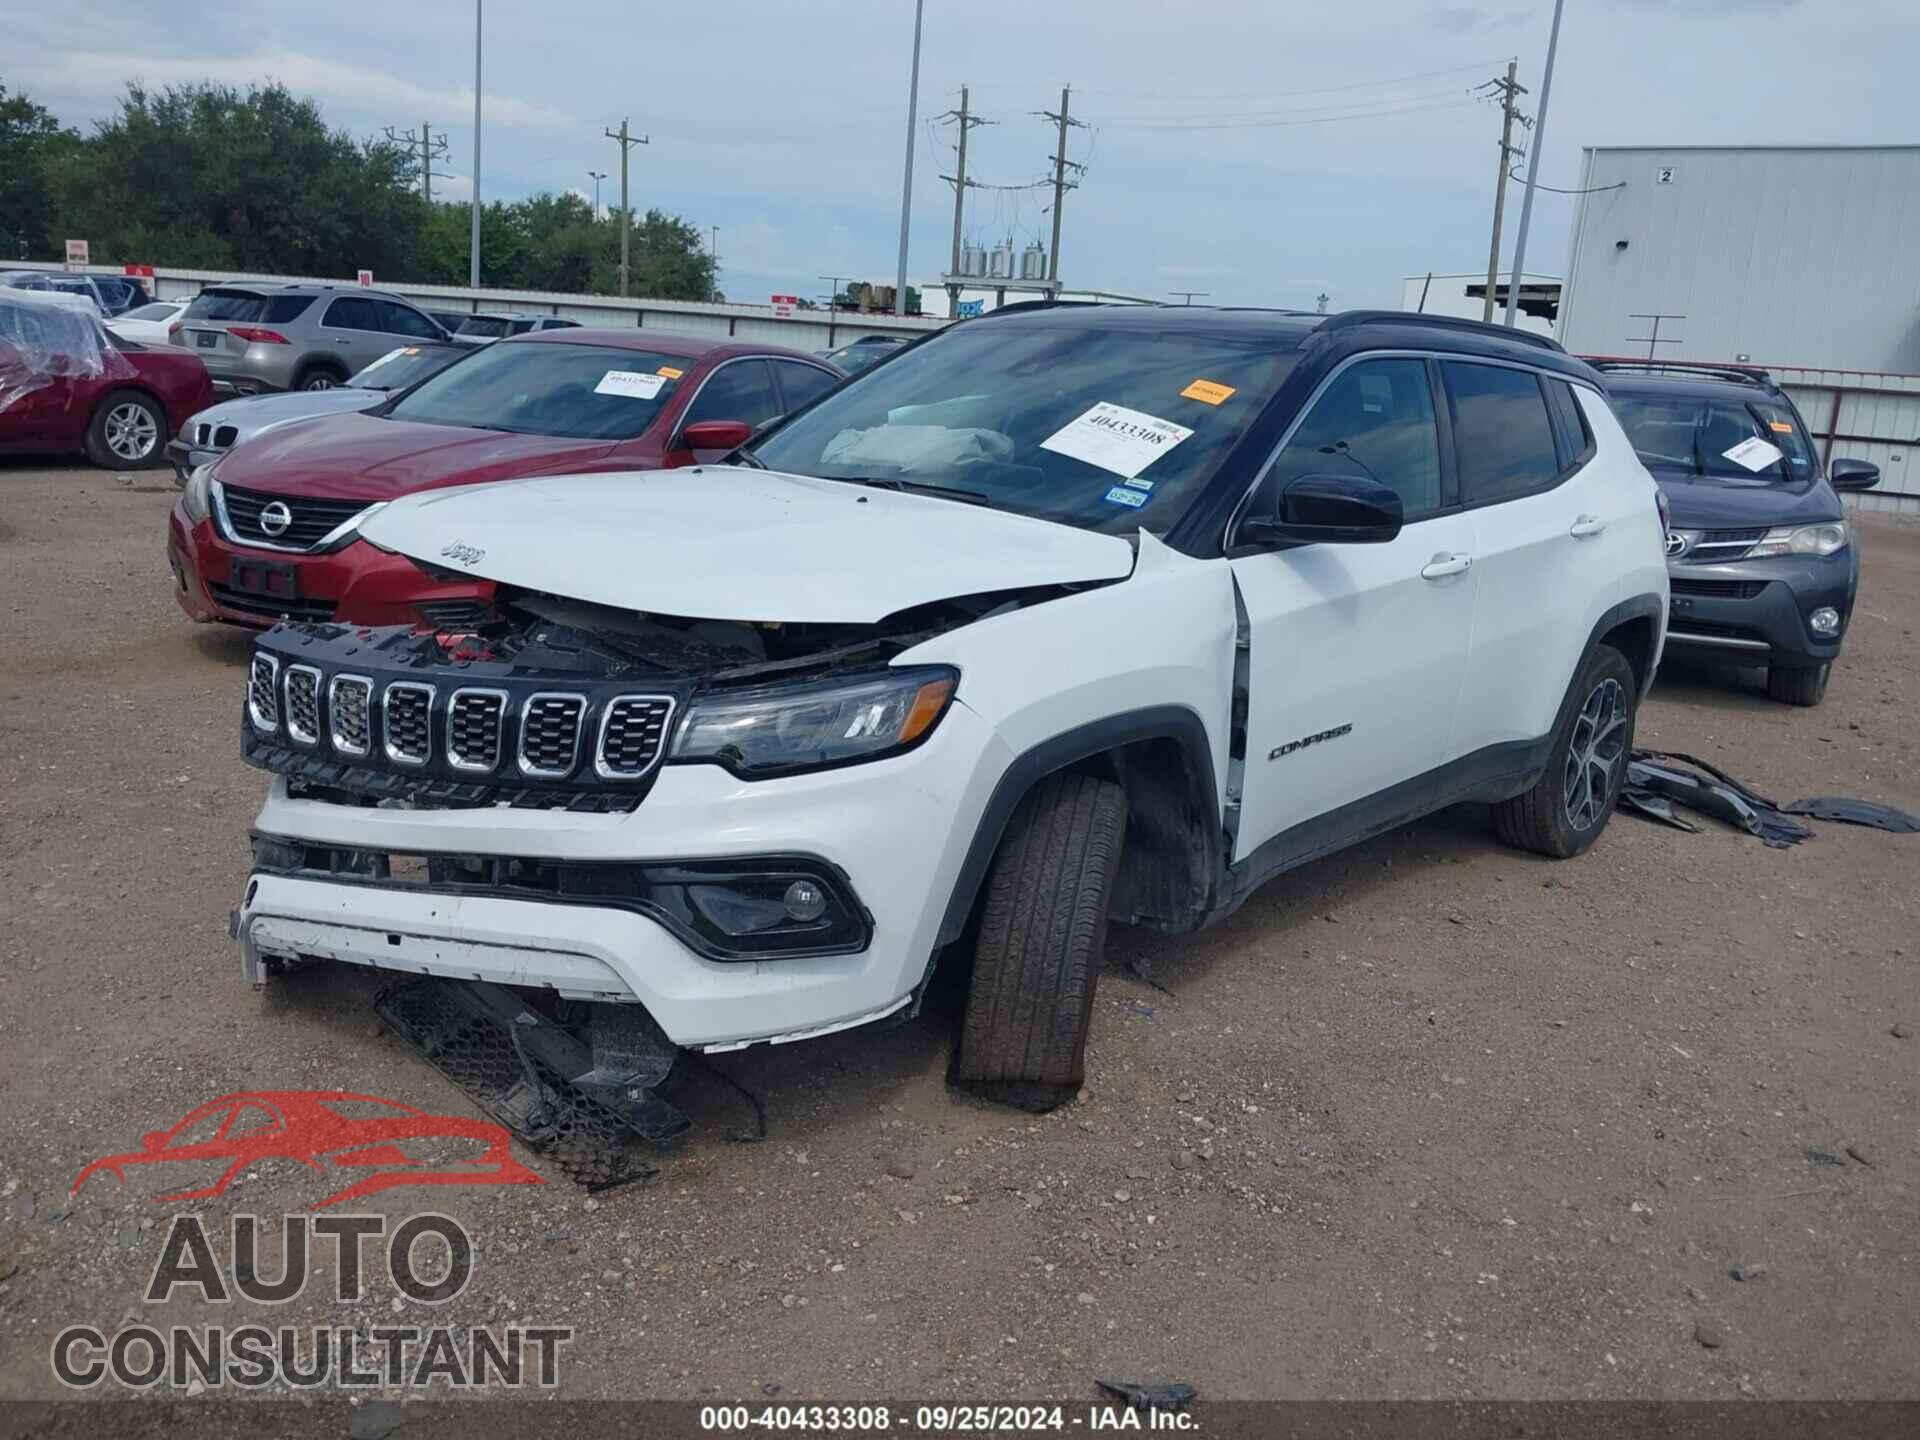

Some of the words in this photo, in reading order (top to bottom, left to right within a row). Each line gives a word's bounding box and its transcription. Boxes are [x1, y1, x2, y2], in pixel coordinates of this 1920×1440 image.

[1661, 170, 1672, 182] 2
[1089, 415, 1168, 446] 40433308
[441, 537, 486, 568] Jeep
[1267, 722, 1353, 762] COMPASS
